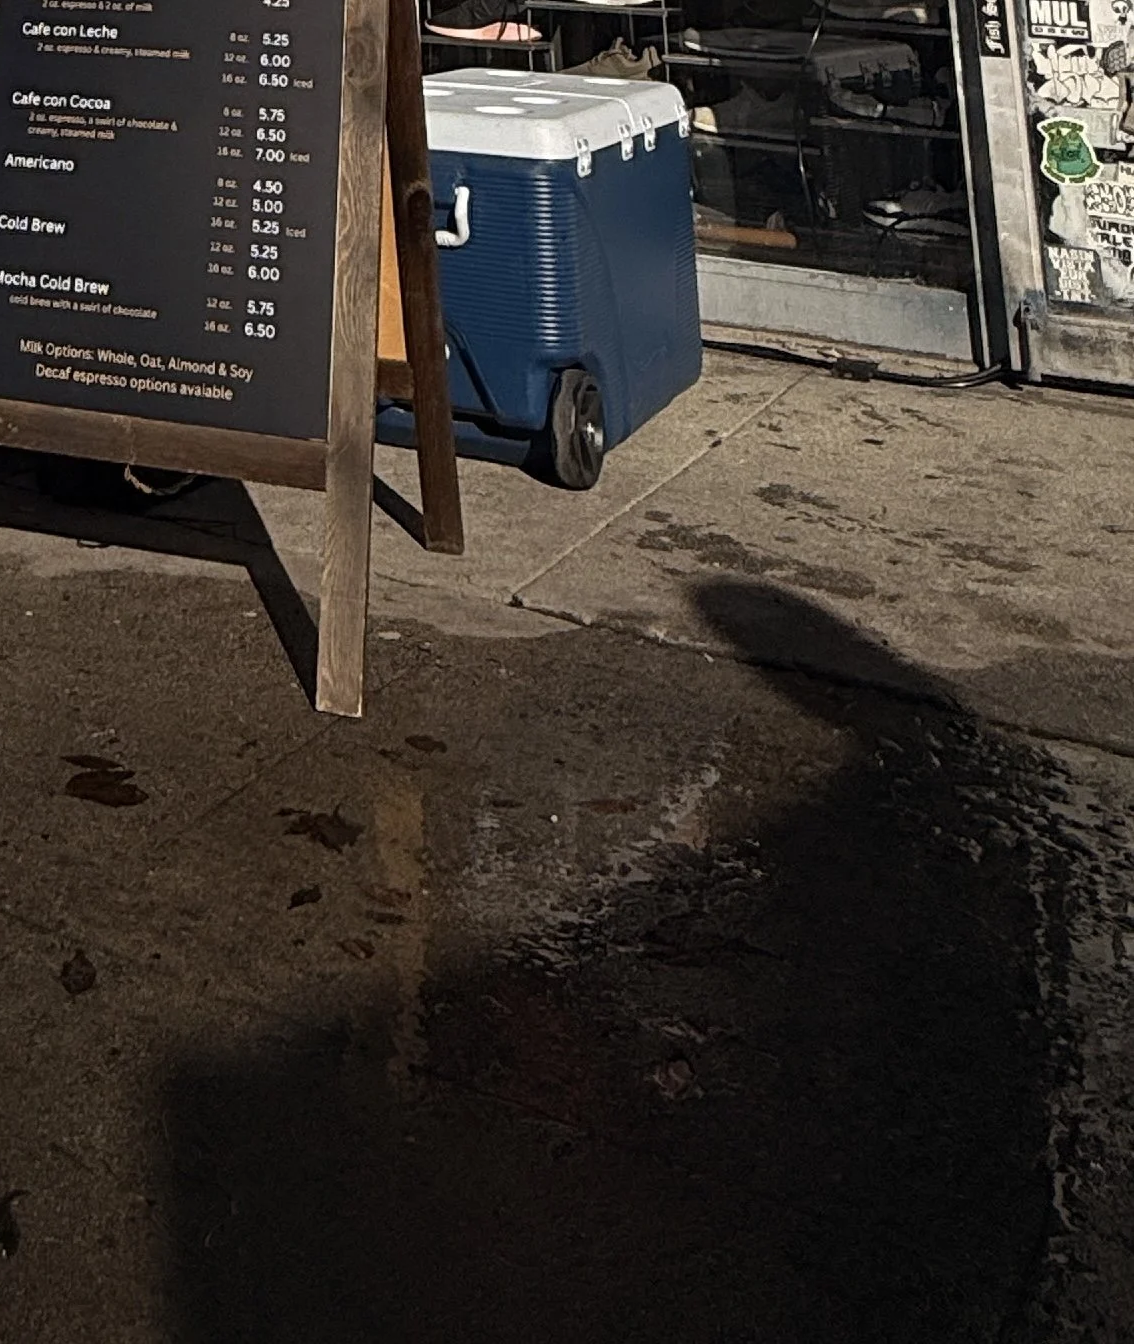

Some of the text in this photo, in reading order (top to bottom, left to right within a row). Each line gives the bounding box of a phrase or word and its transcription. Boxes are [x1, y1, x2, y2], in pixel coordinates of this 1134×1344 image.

[60, 0, 98, 11] espresso
[124, 2, 134, 11] of
[135, 2, 153, 12] milk
[22, 22, 118, 39] Cafe con Leche
[262, 33, 289, 47] 5.25
[56, 44, 93, 54] espresso
[224, 52, 234, 63] 12
[260, 54, 291, 68] 6.00
[258, 73, 289, 88] 6.50
[12, 91, 111, 110] Cafe con Cocoa
[258, 107, 285, 122] 5.75
[218, 126, 230, 137] 12
[256, 127, 286, 142] 6.50
[4, 153, 75, 172] Americano
[255, 148, 285, 162] 7.00
[253, 179, 283, 194] 4.50
[213, 196, 224, 207] 12
[252, 198, 283, 214] 5.00
[31, 217, 66, 234] Brew
[252, 219, 279, 234] 5.25
[210, 241, 221, 252] 12
[250, 244, 278, 260] 5.25
[248, 265, 280, 281] 6.00
[39, 274, 71, 291] Cold
[74, 278, 110, 295] Brew
[102, 304, 112, 314] of
[207, 297, 218, 308] 12
[247, 300, 275, 316] 5.75
[244, 323, 275, 339] 6.50
[19, 339, 254, 383] Milk Options: Whole, Oat, Almond & Soy
[35, 363, 72, 380] Decaf
[72, 370, 127, 386] espresso
[129, 375, 177, 393] options
